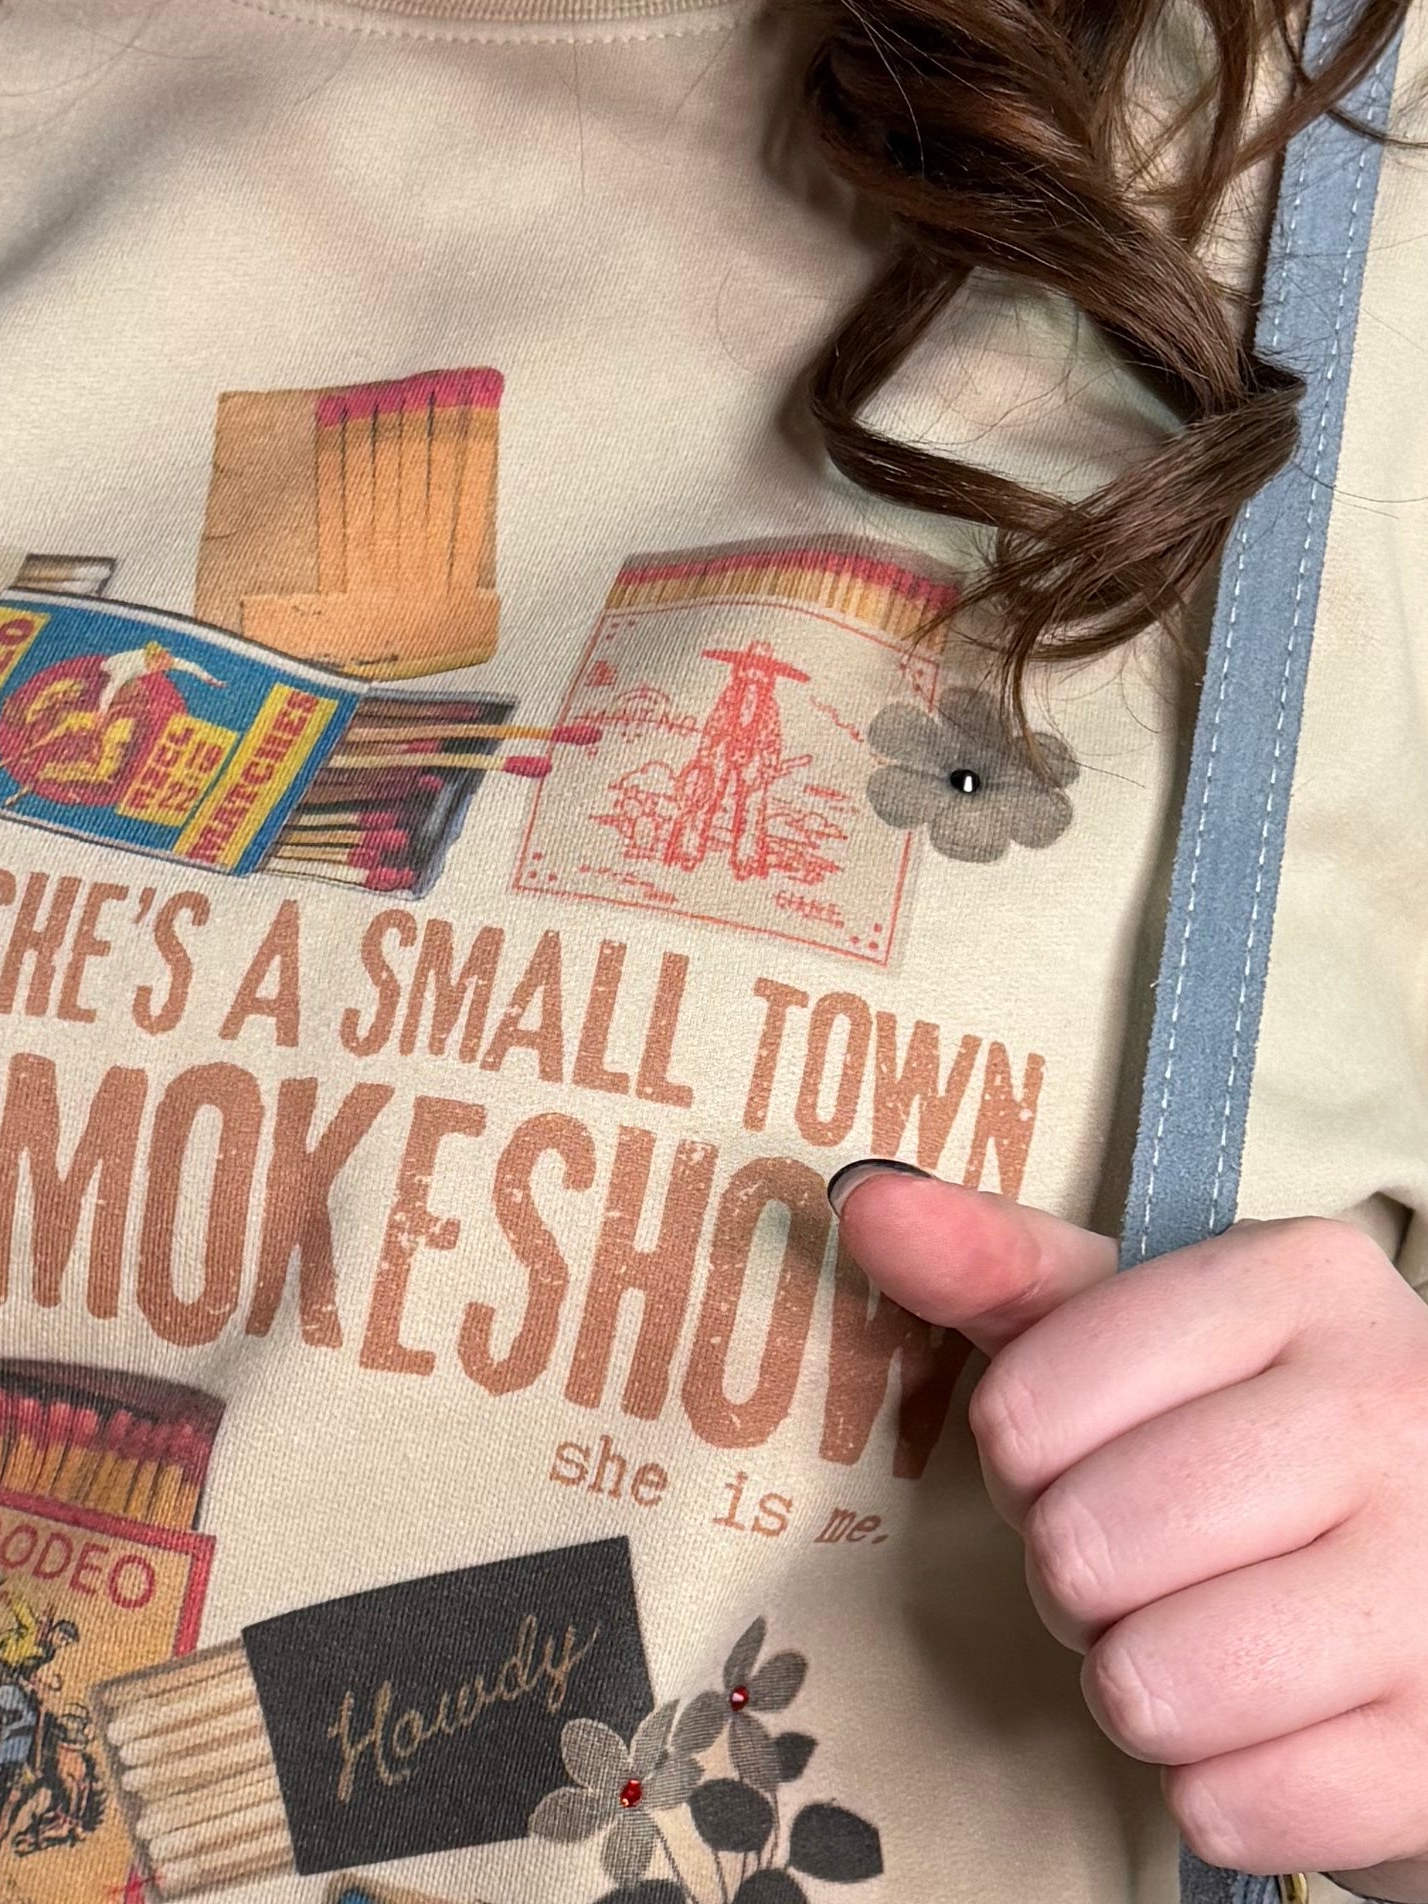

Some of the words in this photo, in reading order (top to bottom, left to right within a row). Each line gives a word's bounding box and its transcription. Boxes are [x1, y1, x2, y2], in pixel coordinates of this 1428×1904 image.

[185, 689, 322, 864] MATCHES
[218, 898, 301, 1048] A
[339, 908, 695, 1110] SMALL
[740, 976, 1047, 1202] TOWN
[548, 1434, 669, 1508] she
[712, 1470, 794, 1538] is
[327, 1613, 601, 1804] Howdy
